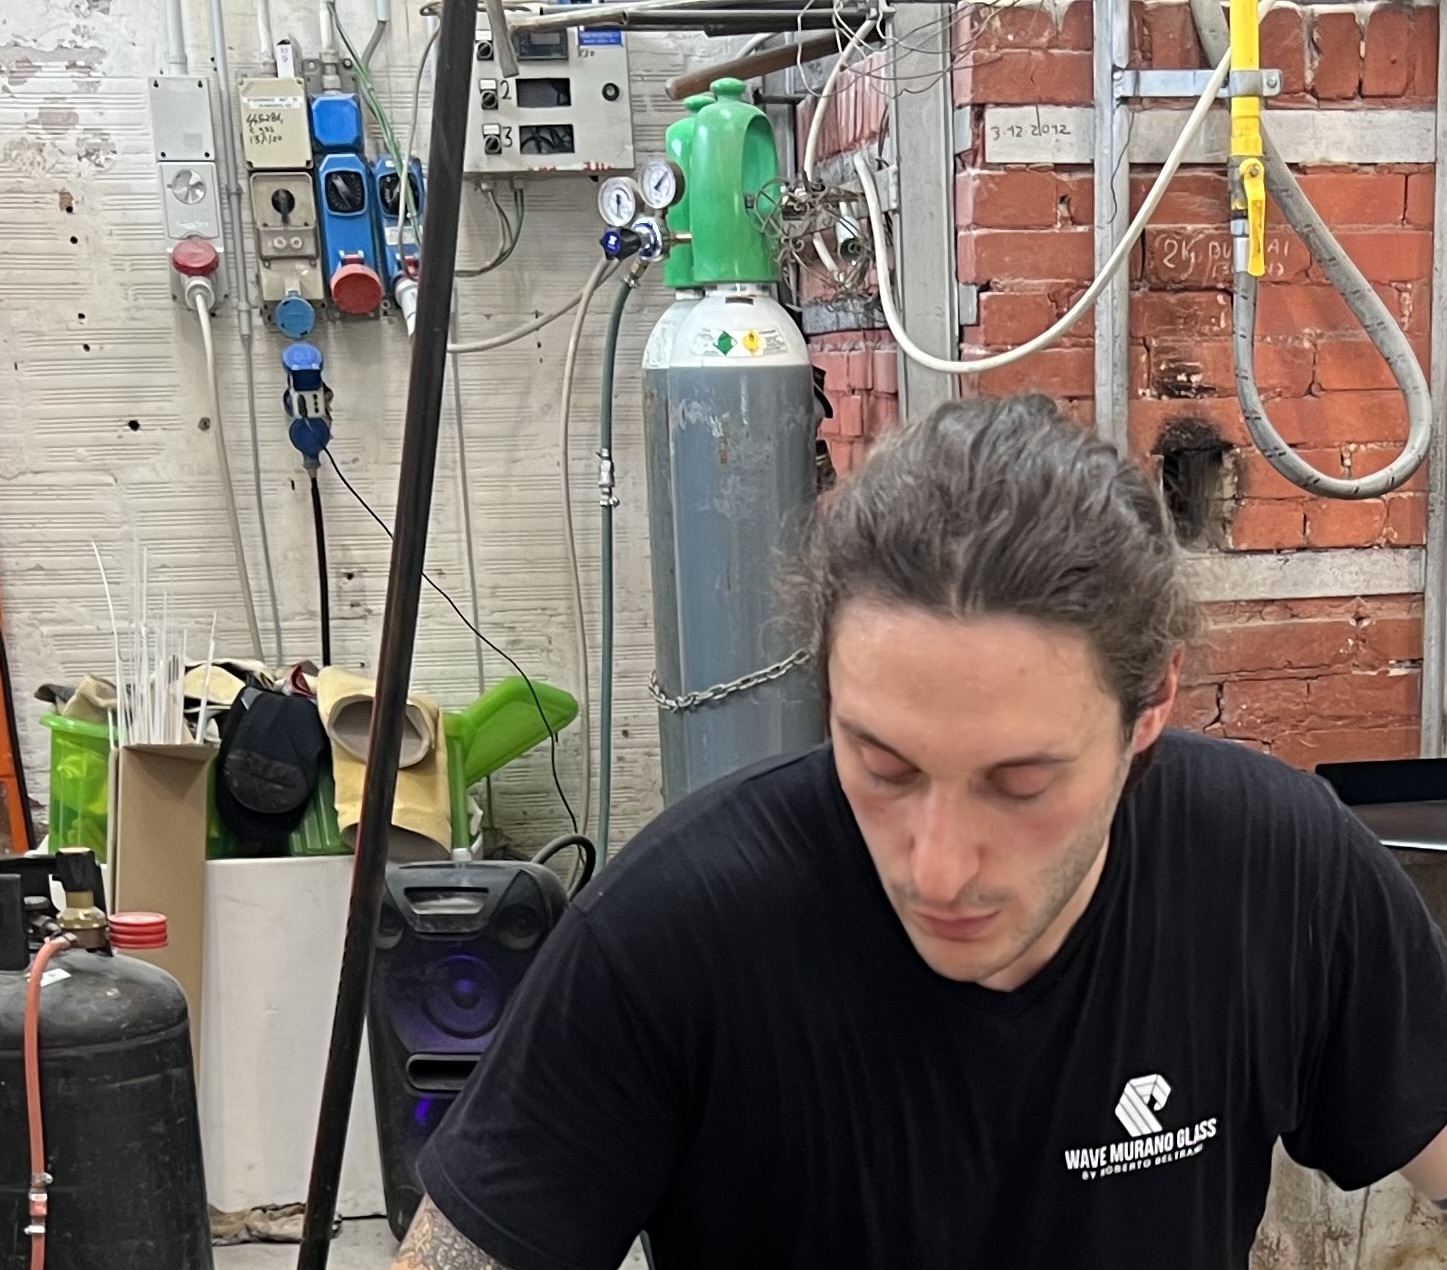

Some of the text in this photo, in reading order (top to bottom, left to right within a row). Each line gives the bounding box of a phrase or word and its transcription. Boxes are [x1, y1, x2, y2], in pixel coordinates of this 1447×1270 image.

[500, 80, 512, 100] 2
[502, 126, 513, 148] 3
[1065, 1118, 1217, 1170] WAVE MURANO GLASS
